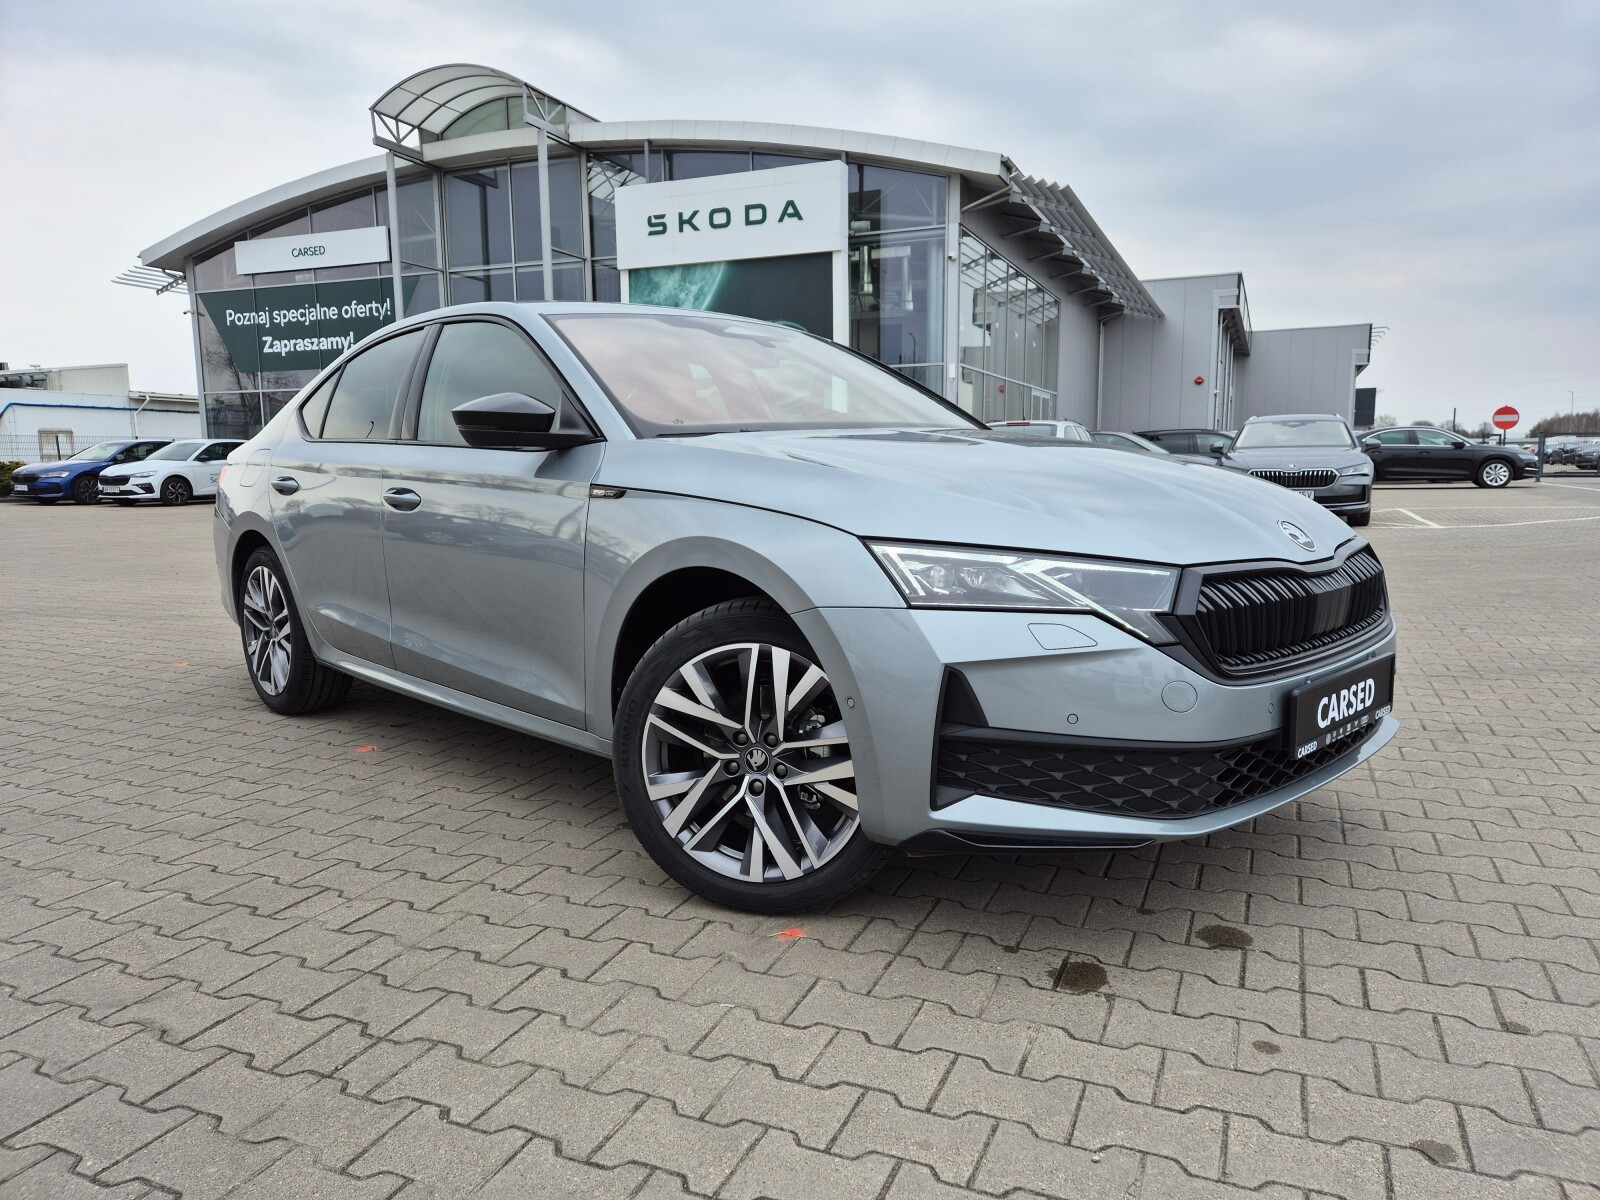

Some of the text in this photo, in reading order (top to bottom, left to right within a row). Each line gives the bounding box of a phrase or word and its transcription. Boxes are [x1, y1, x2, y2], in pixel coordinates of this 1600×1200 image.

[291, 246, 326, 257] CARSED
[226, 297, 391, 327] Poznaj specjalne oferty!
[262, 331, 354, 356] Zapraszamy!
[1317, 678, 1375, 729] CARSED
[621, 699, 637, 767] KUMHO
[1297, 741, 1317, 758] CARSED
